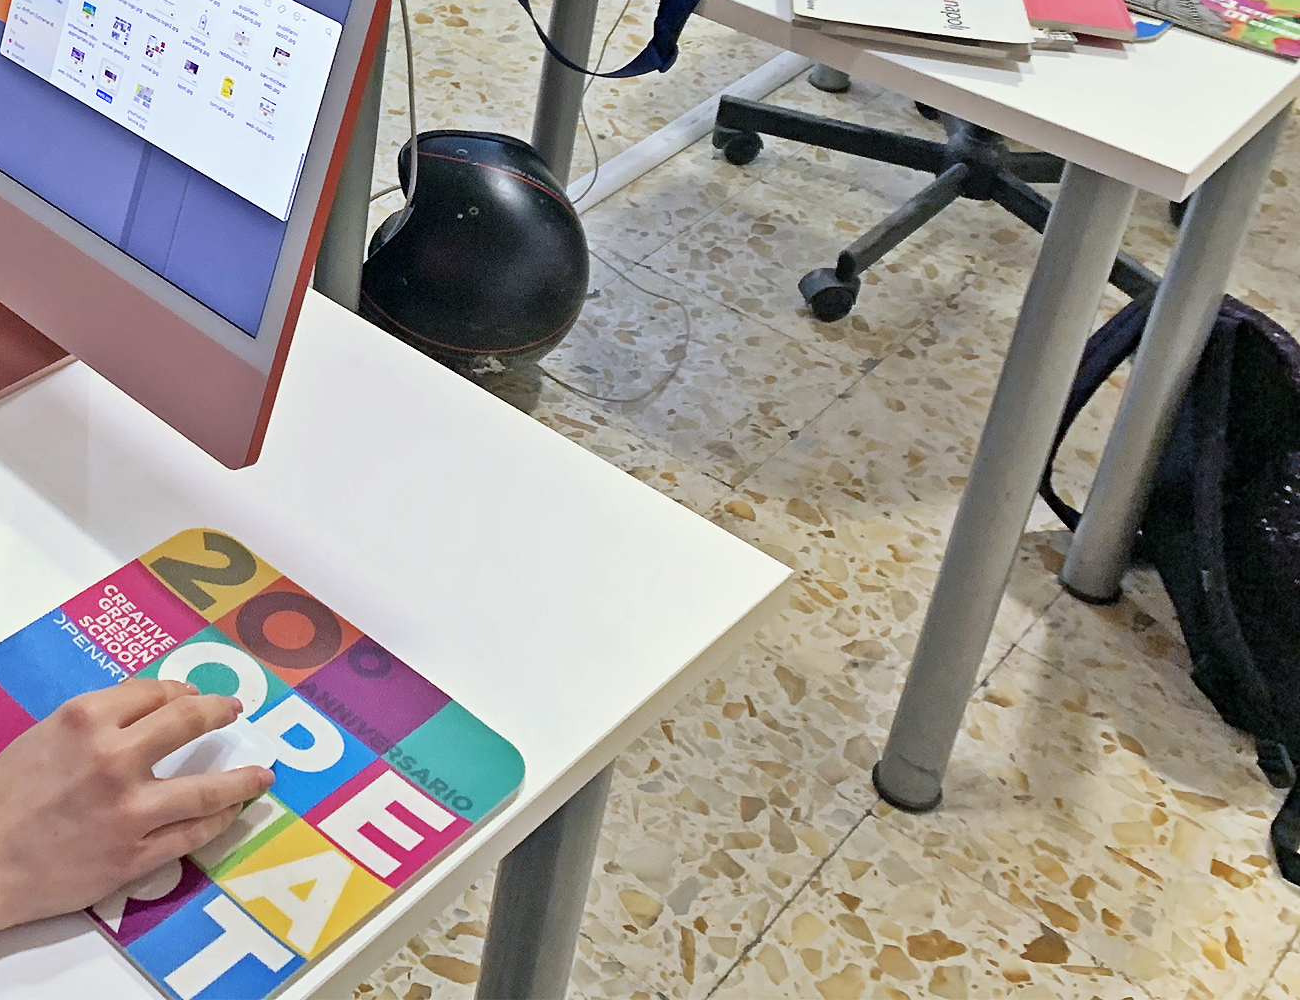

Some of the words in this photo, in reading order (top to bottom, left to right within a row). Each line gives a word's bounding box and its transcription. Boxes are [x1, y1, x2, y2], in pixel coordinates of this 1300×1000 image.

[261, 80, 281, 96] web.jpg
[78, 615, 140, 672] SCHOOL
[95, 613, 155, 664] DESIGN
[98, 597, 166, 656] GRAPHIC
[103, 584, 178, 649] CREATIVE
[299, 683, 475, 814] ANNIVERSARIO
